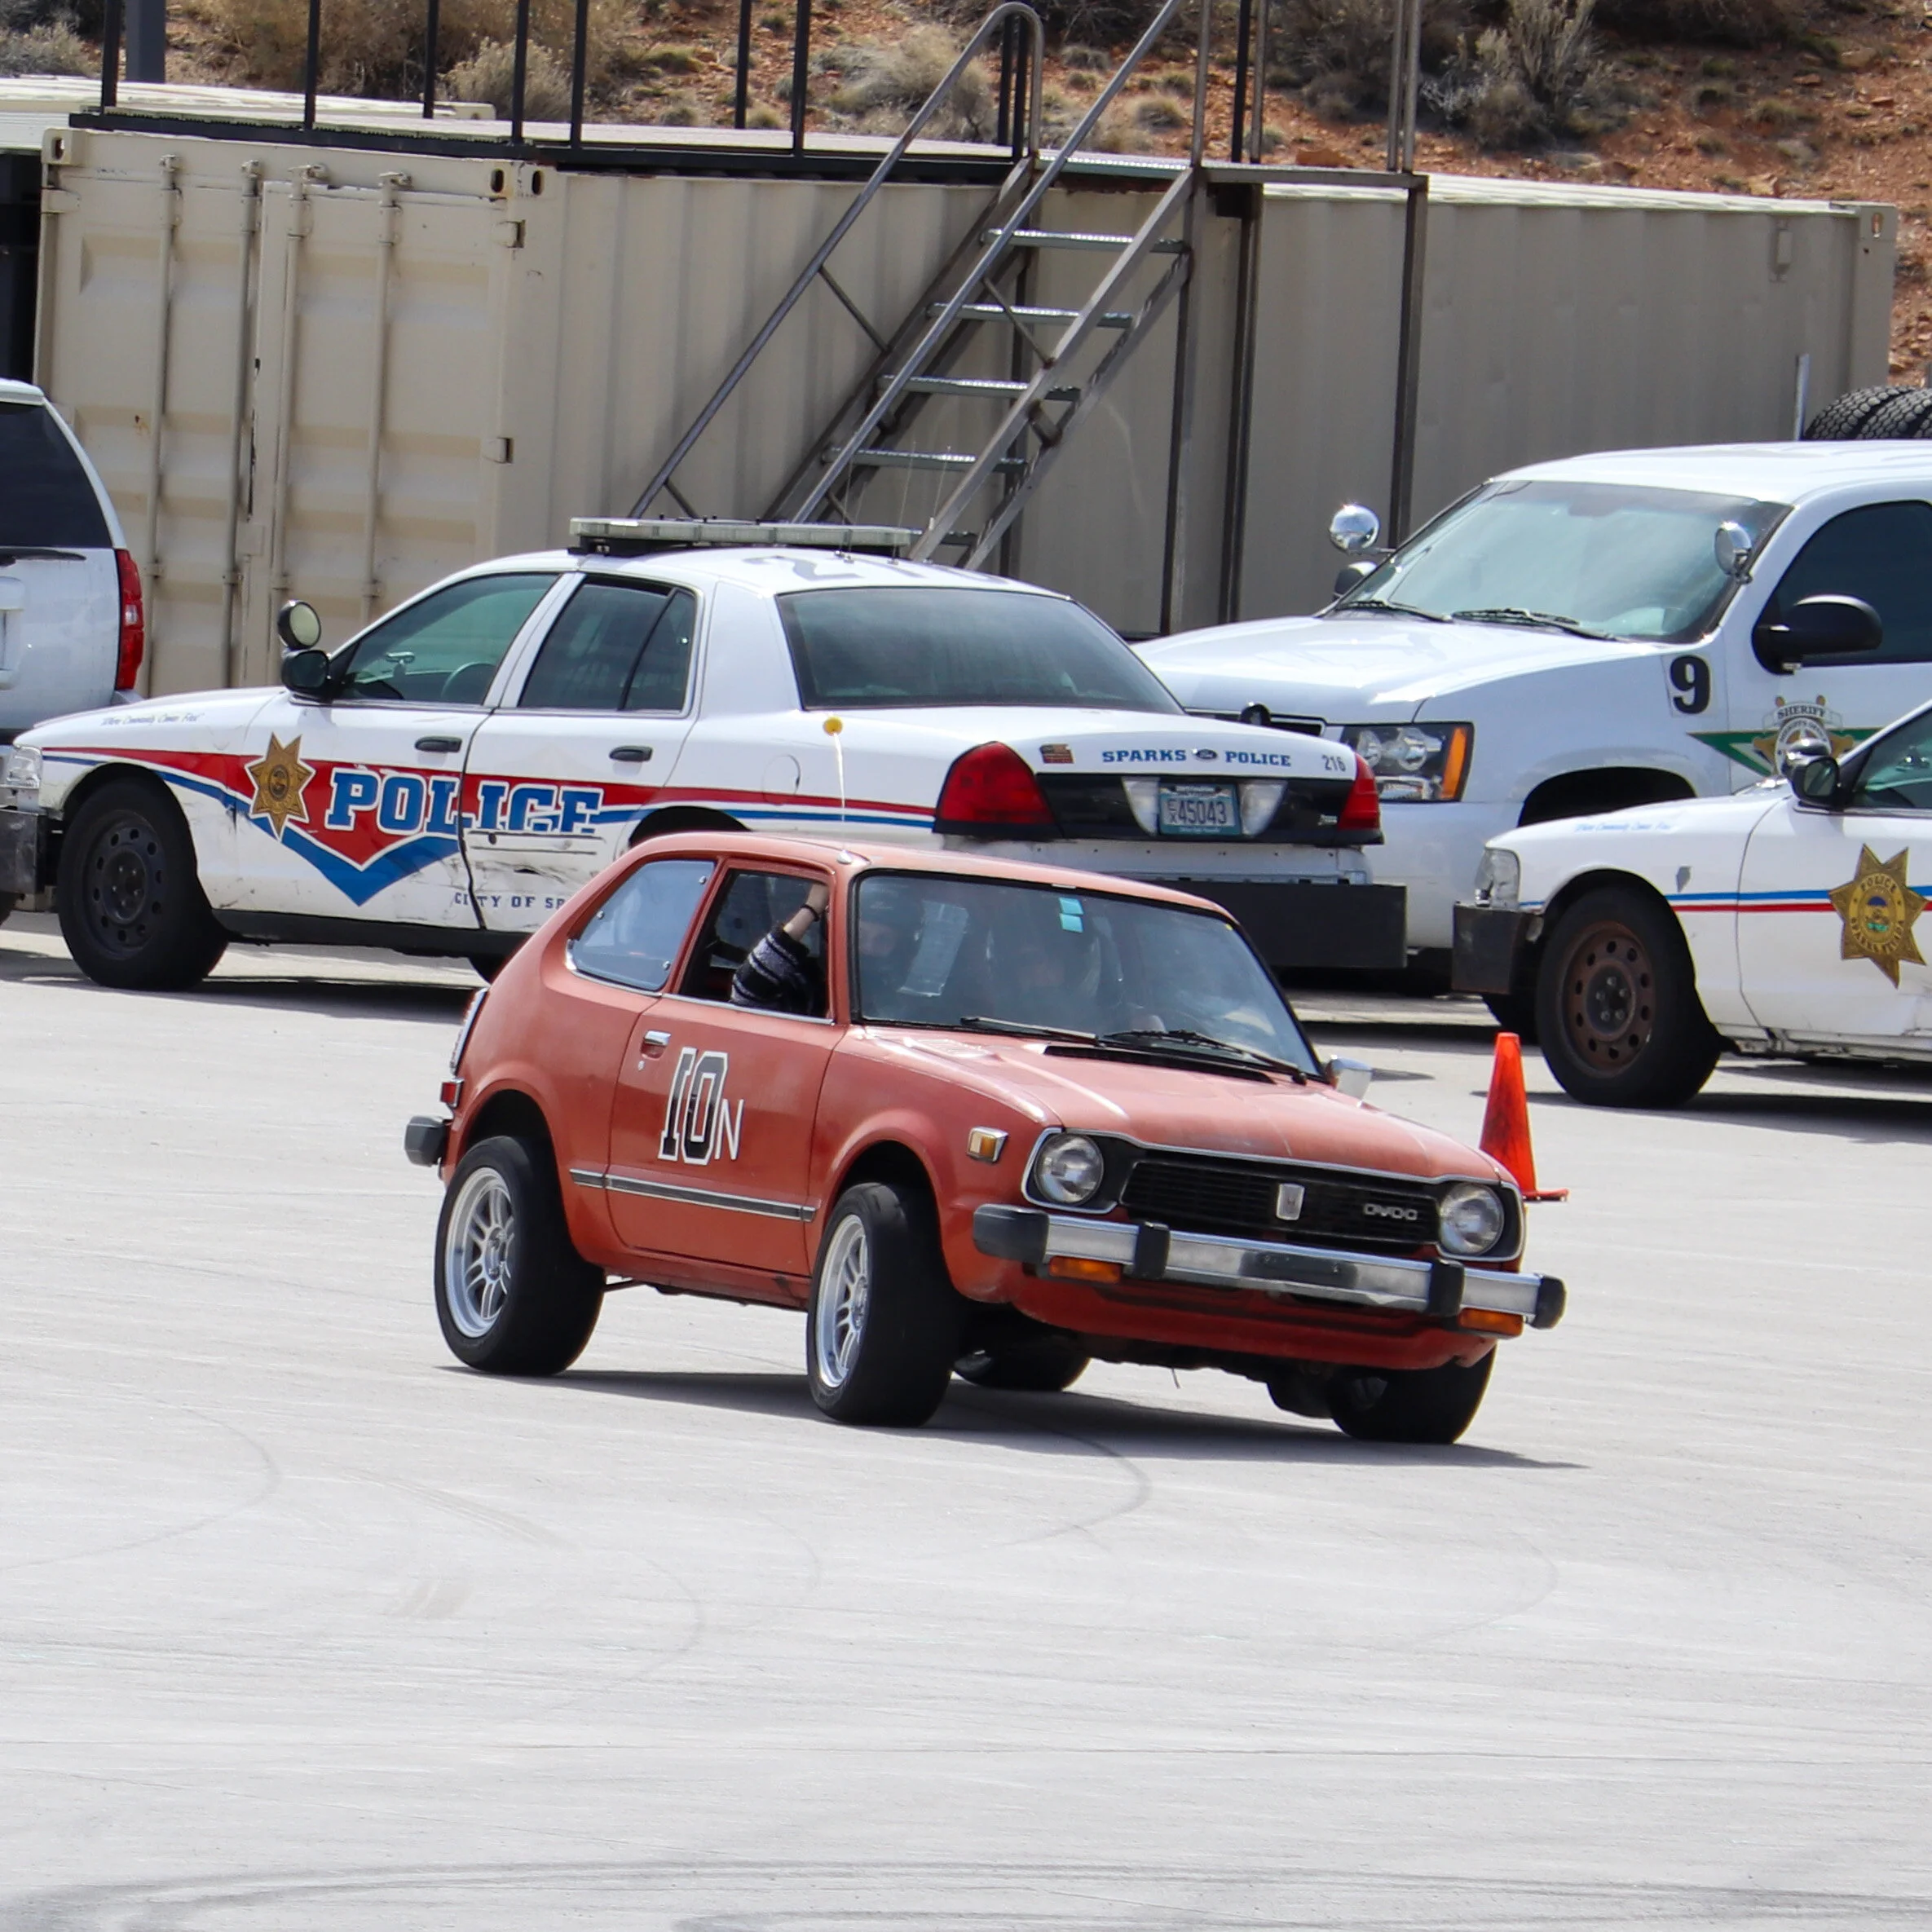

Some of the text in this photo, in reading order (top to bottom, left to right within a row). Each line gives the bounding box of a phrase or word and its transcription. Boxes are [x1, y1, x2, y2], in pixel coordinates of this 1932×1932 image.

[1670, 655, 1710, 714] 9
[1777, 705, 1825, 718] SHERIFF
[1102, 749, 1186, 762] SPARKS
[1225, 751, 1291, 767] POLICE
[1322, 754, 1347, 772] 216
[324, 767, 605, 834] POLICE
[454, 892, 567, 909] CITY OF SP
